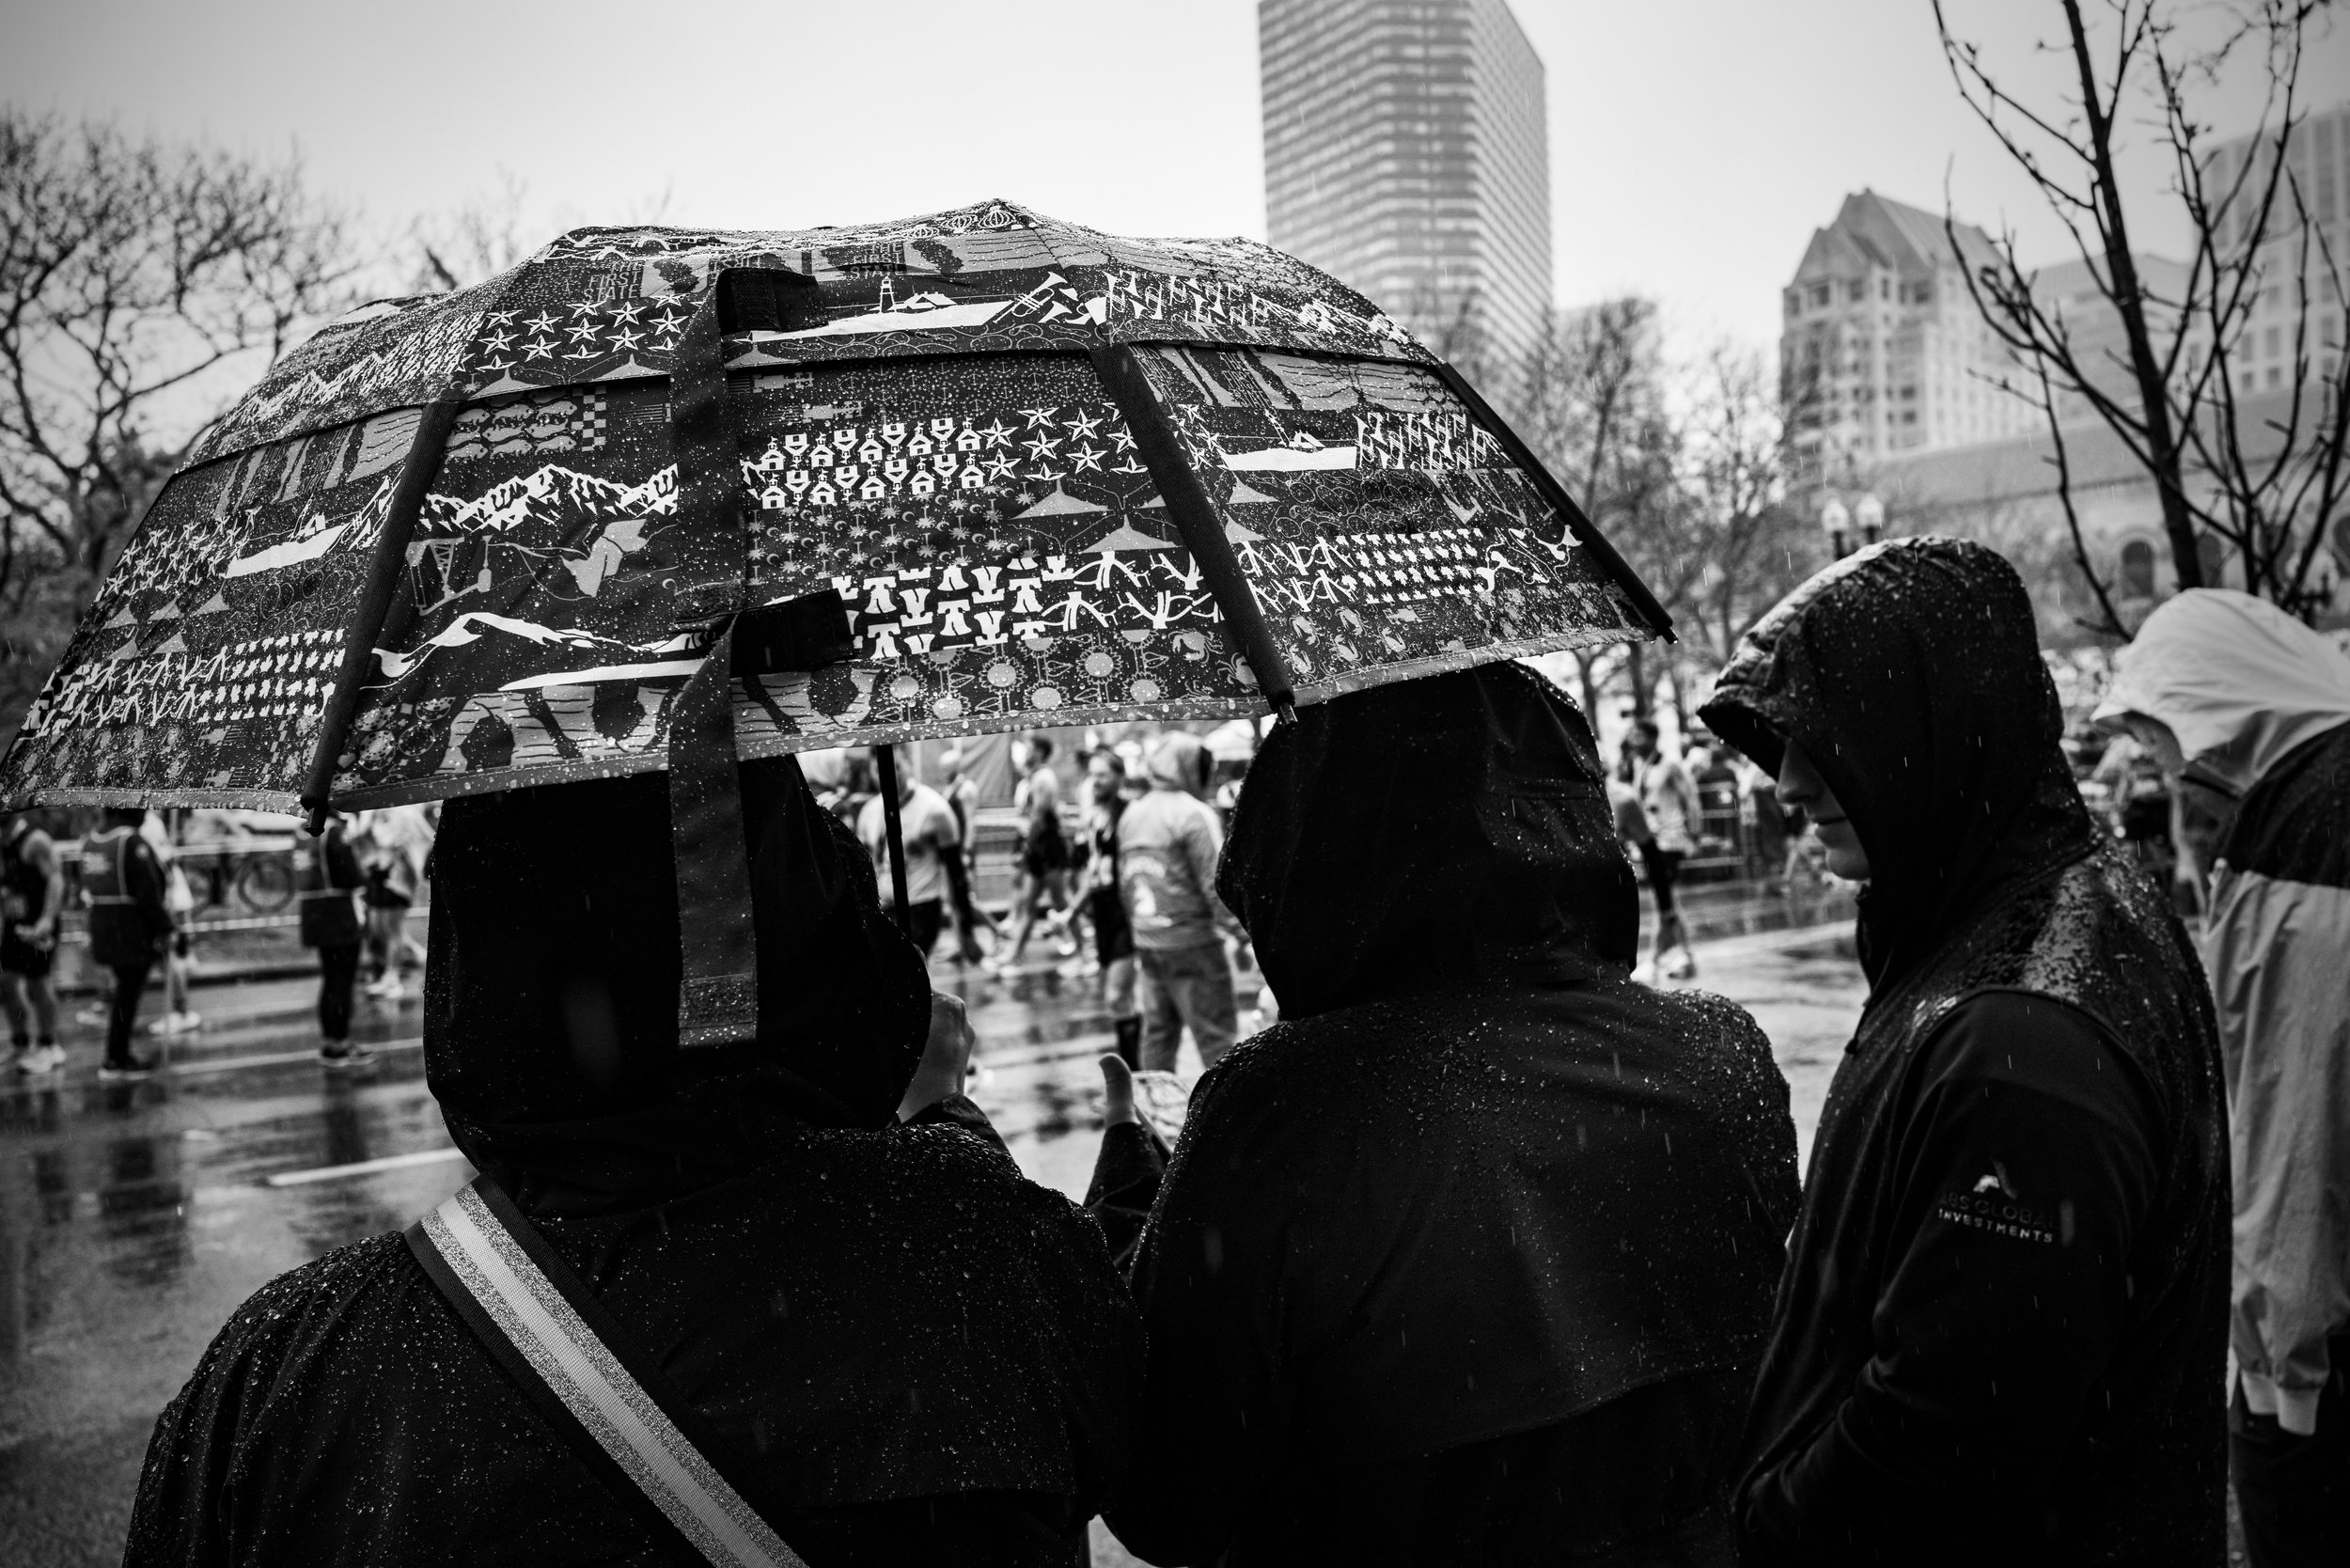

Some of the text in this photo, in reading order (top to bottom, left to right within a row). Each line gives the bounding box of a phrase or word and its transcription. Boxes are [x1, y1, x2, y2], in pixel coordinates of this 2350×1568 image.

[870, 241, 903, 253] THE
[611, 260, 642, 274] THE
[853, 253, 901, 264] FIRST
[588, 270, 641, 288] FIRST
[850, 264, 904, 280] STATE
[583, 284, 639, 302] STATE
[1216, 353, 1249, 370] THE
[1222, 369, 1259, 390] FIRST
[1937, 1207, 2054, 1244] INVESTMENTS
